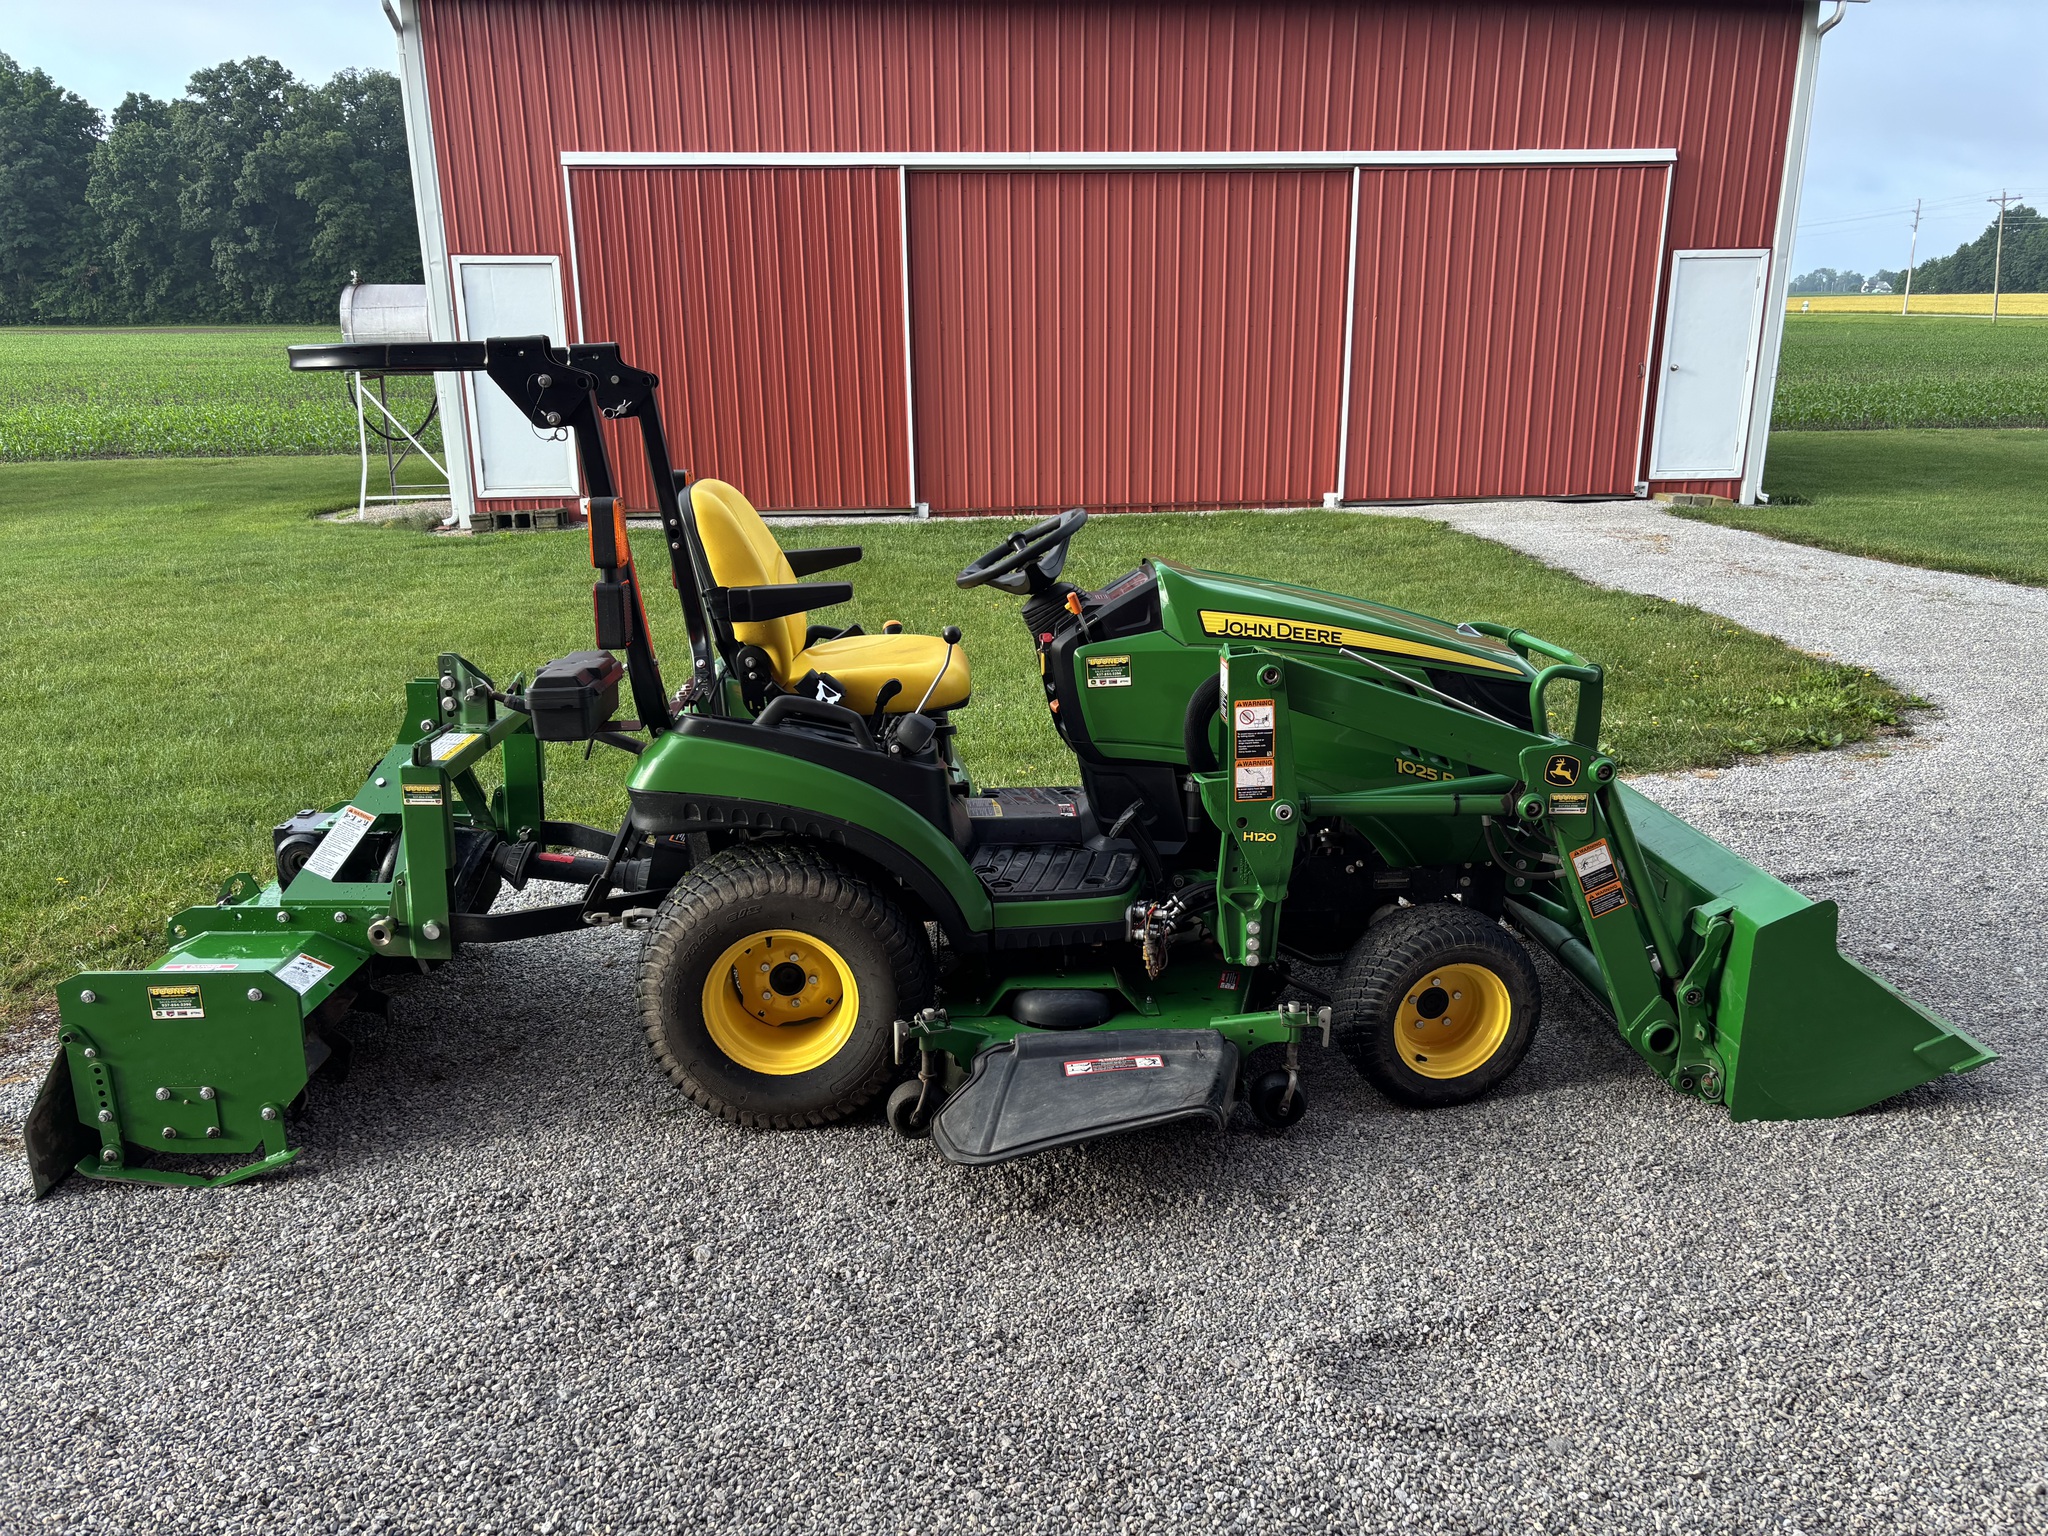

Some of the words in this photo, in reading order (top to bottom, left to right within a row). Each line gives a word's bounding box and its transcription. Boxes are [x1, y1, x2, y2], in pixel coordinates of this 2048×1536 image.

[1217, 618, 1272, 637] JOHN
[1276, 622, 1343, 644] DEERE
[1242, 759, 1273, 767] WARNING
[1395, 757, 1439, 781] 1025
[1243, 831, 1277, 842] H120
[1579, 841, 1603, 854] WARNING
[1595, 884, 1618, 897] WARNING
[152, 986, 197, 996] BOONE'S
